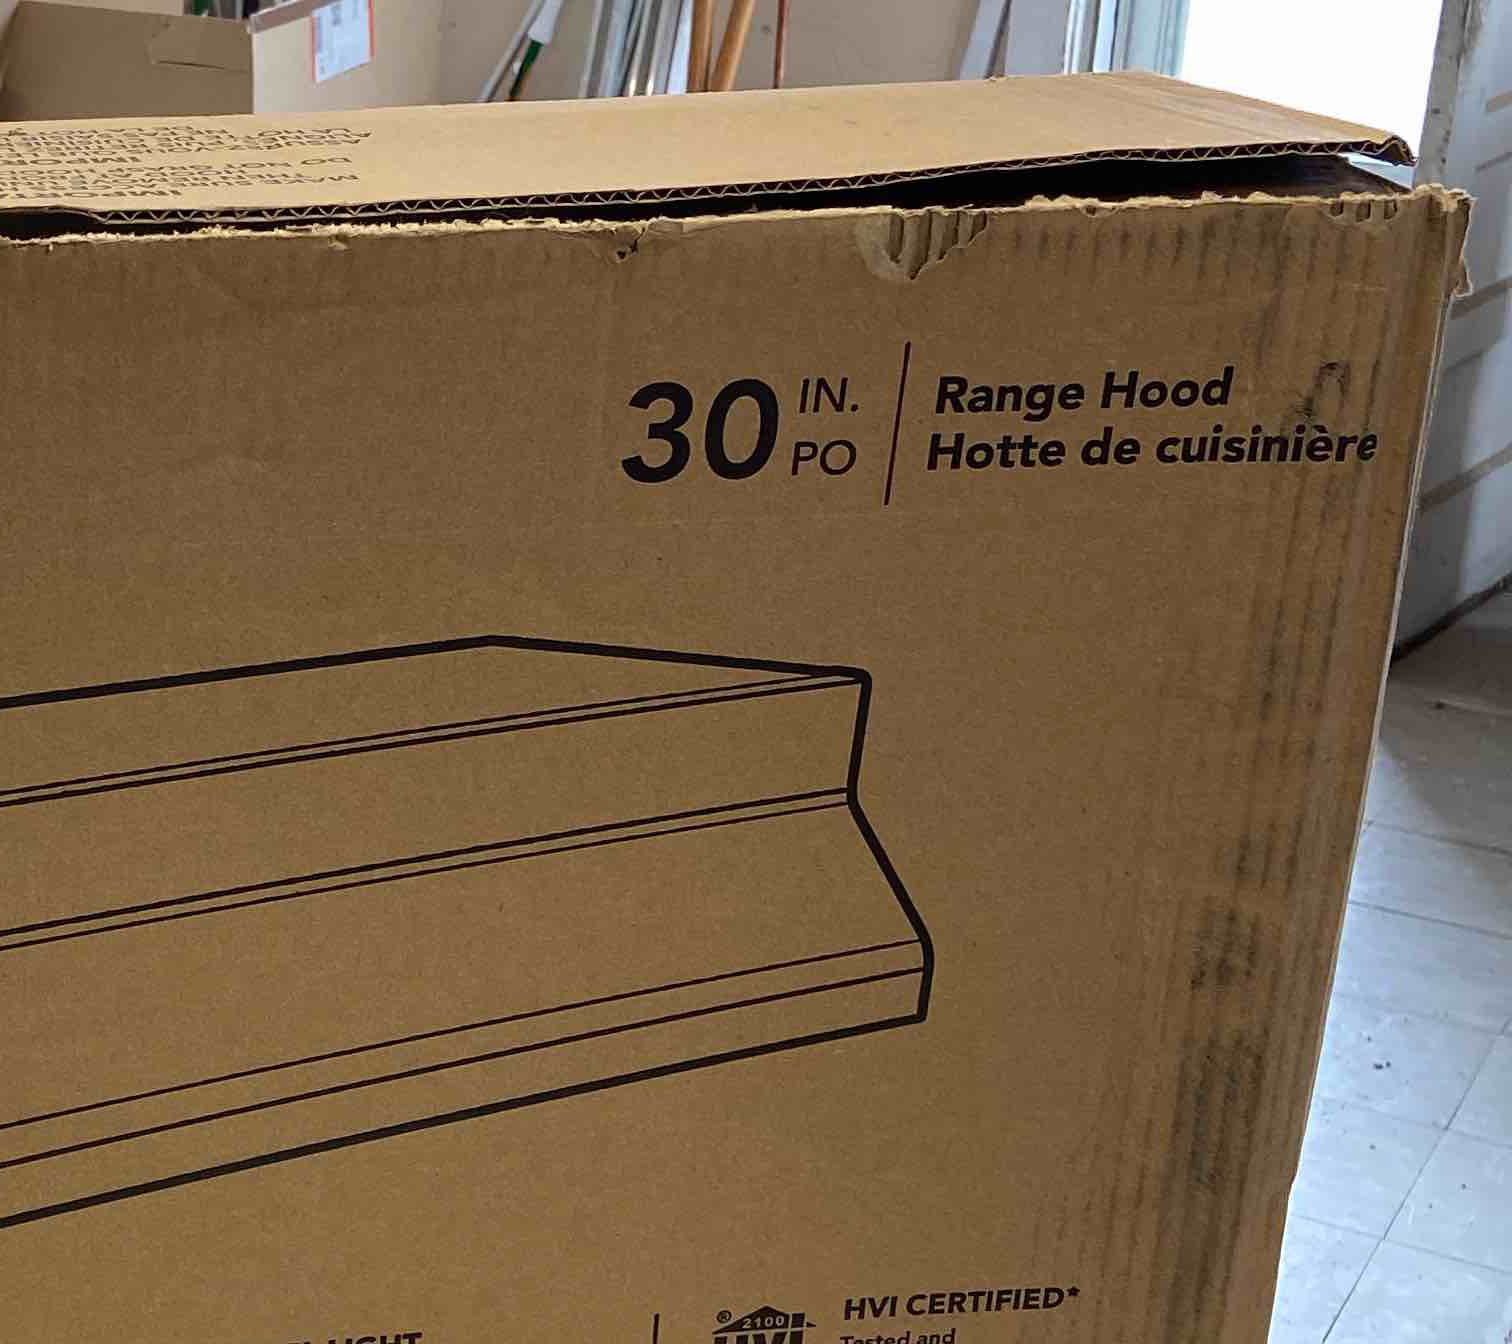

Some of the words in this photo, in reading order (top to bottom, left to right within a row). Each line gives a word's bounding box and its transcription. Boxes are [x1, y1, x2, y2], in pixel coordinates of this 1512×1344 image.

[301, 157, 353, 166] DO
[934, 374, 1086, 423] Range
[1100, 365, 1236, 412] Hood
[621, 377, 781, 485] 30
[798, 376, 861, 415] IN.
[927, 430, 1066, 472] Hotte
[1080, 425, 1138, 468] de
[1156, 416, 1378, 465] cuisinière
[791, 439, 858, 477] PO
[741, 1314, 785, 1331] 2100
[844, 1296, 898, 1320] HVI
